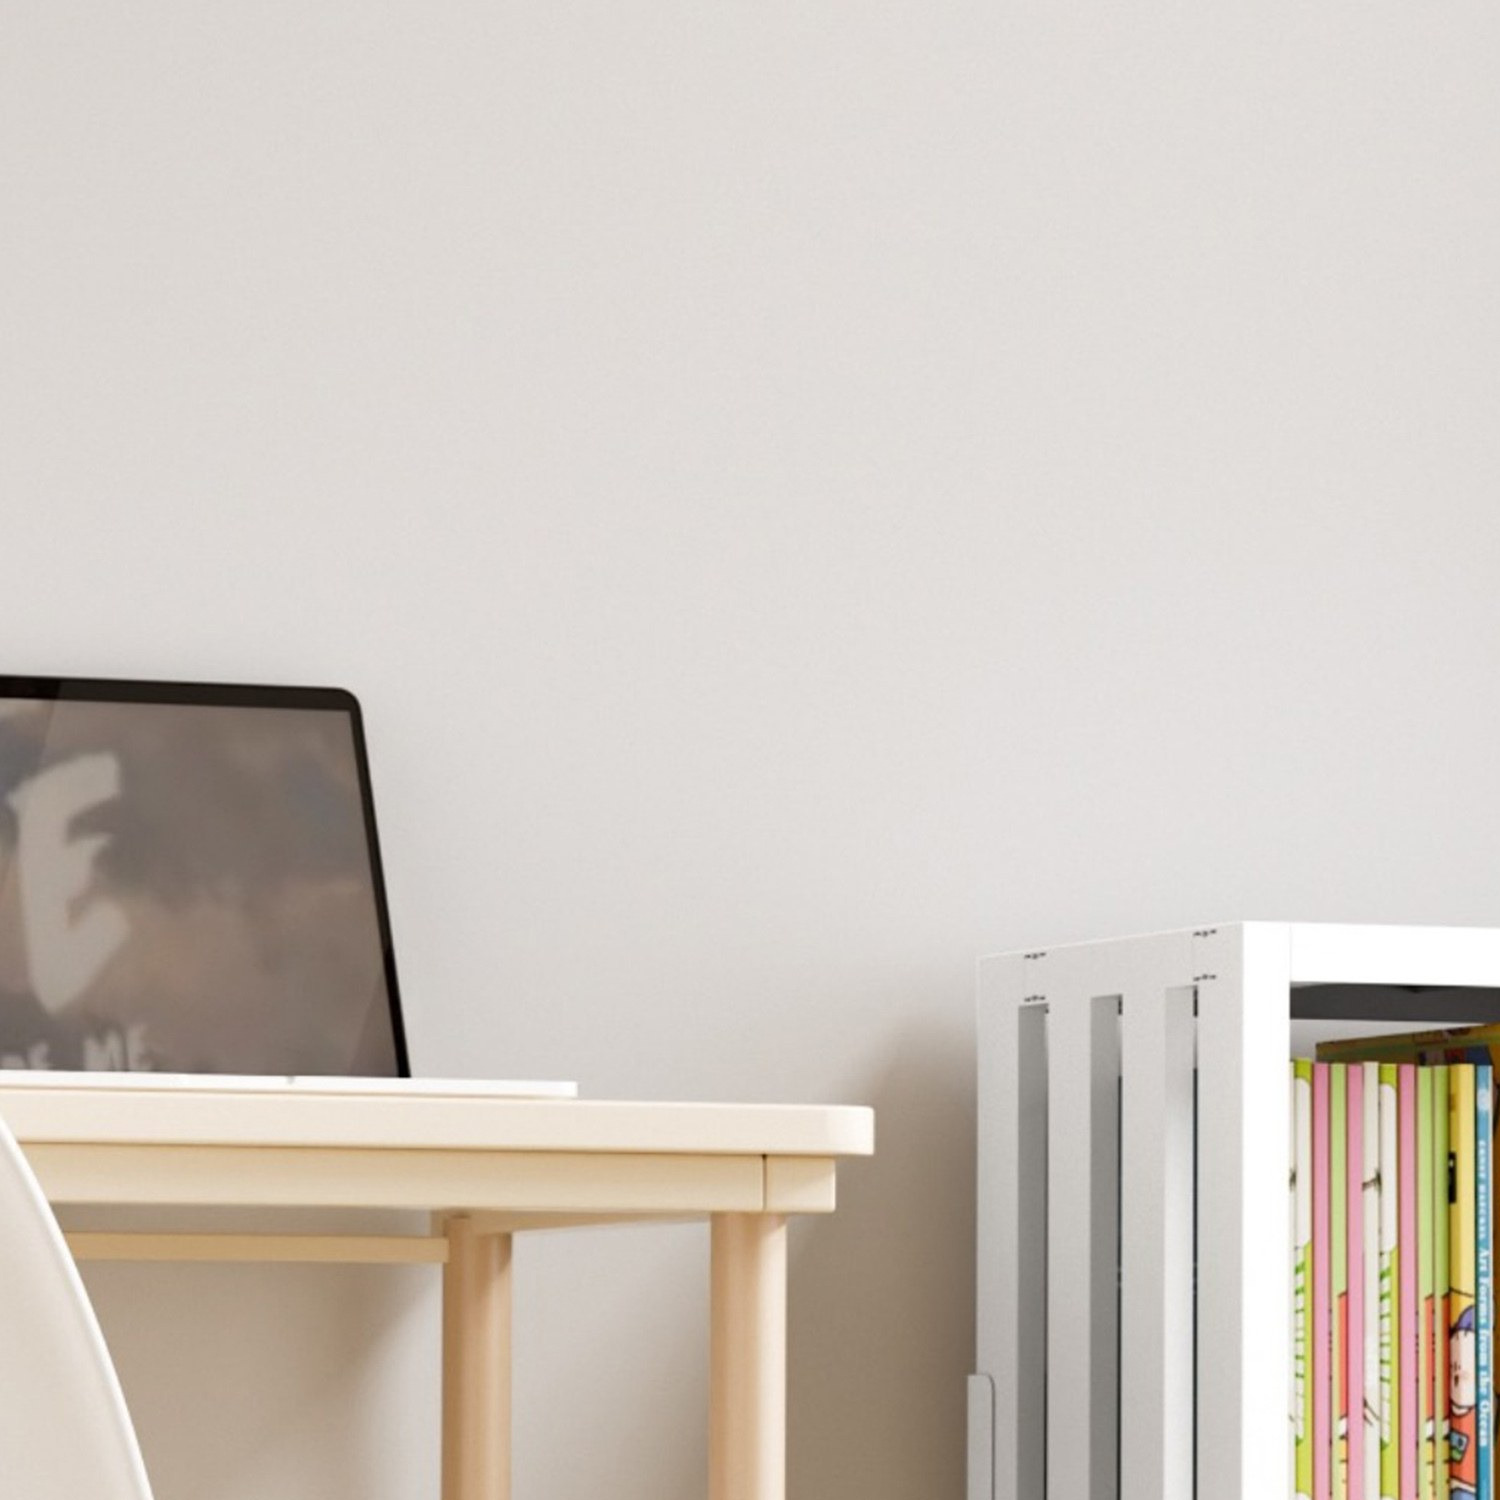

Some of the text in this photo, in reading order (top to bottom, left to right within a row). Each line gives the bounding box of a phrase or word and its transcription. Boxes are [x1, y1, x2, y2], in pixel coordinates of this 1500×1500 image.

[1479, 1248, 1489, 1272] Art
[1479, 1276, 1489, 1326] Forms
[1479, 1328, 1489, 1366] from
[1479, 1370, 1490, 1395] the
[1479, 1399, 1490, 1447] Ocean
